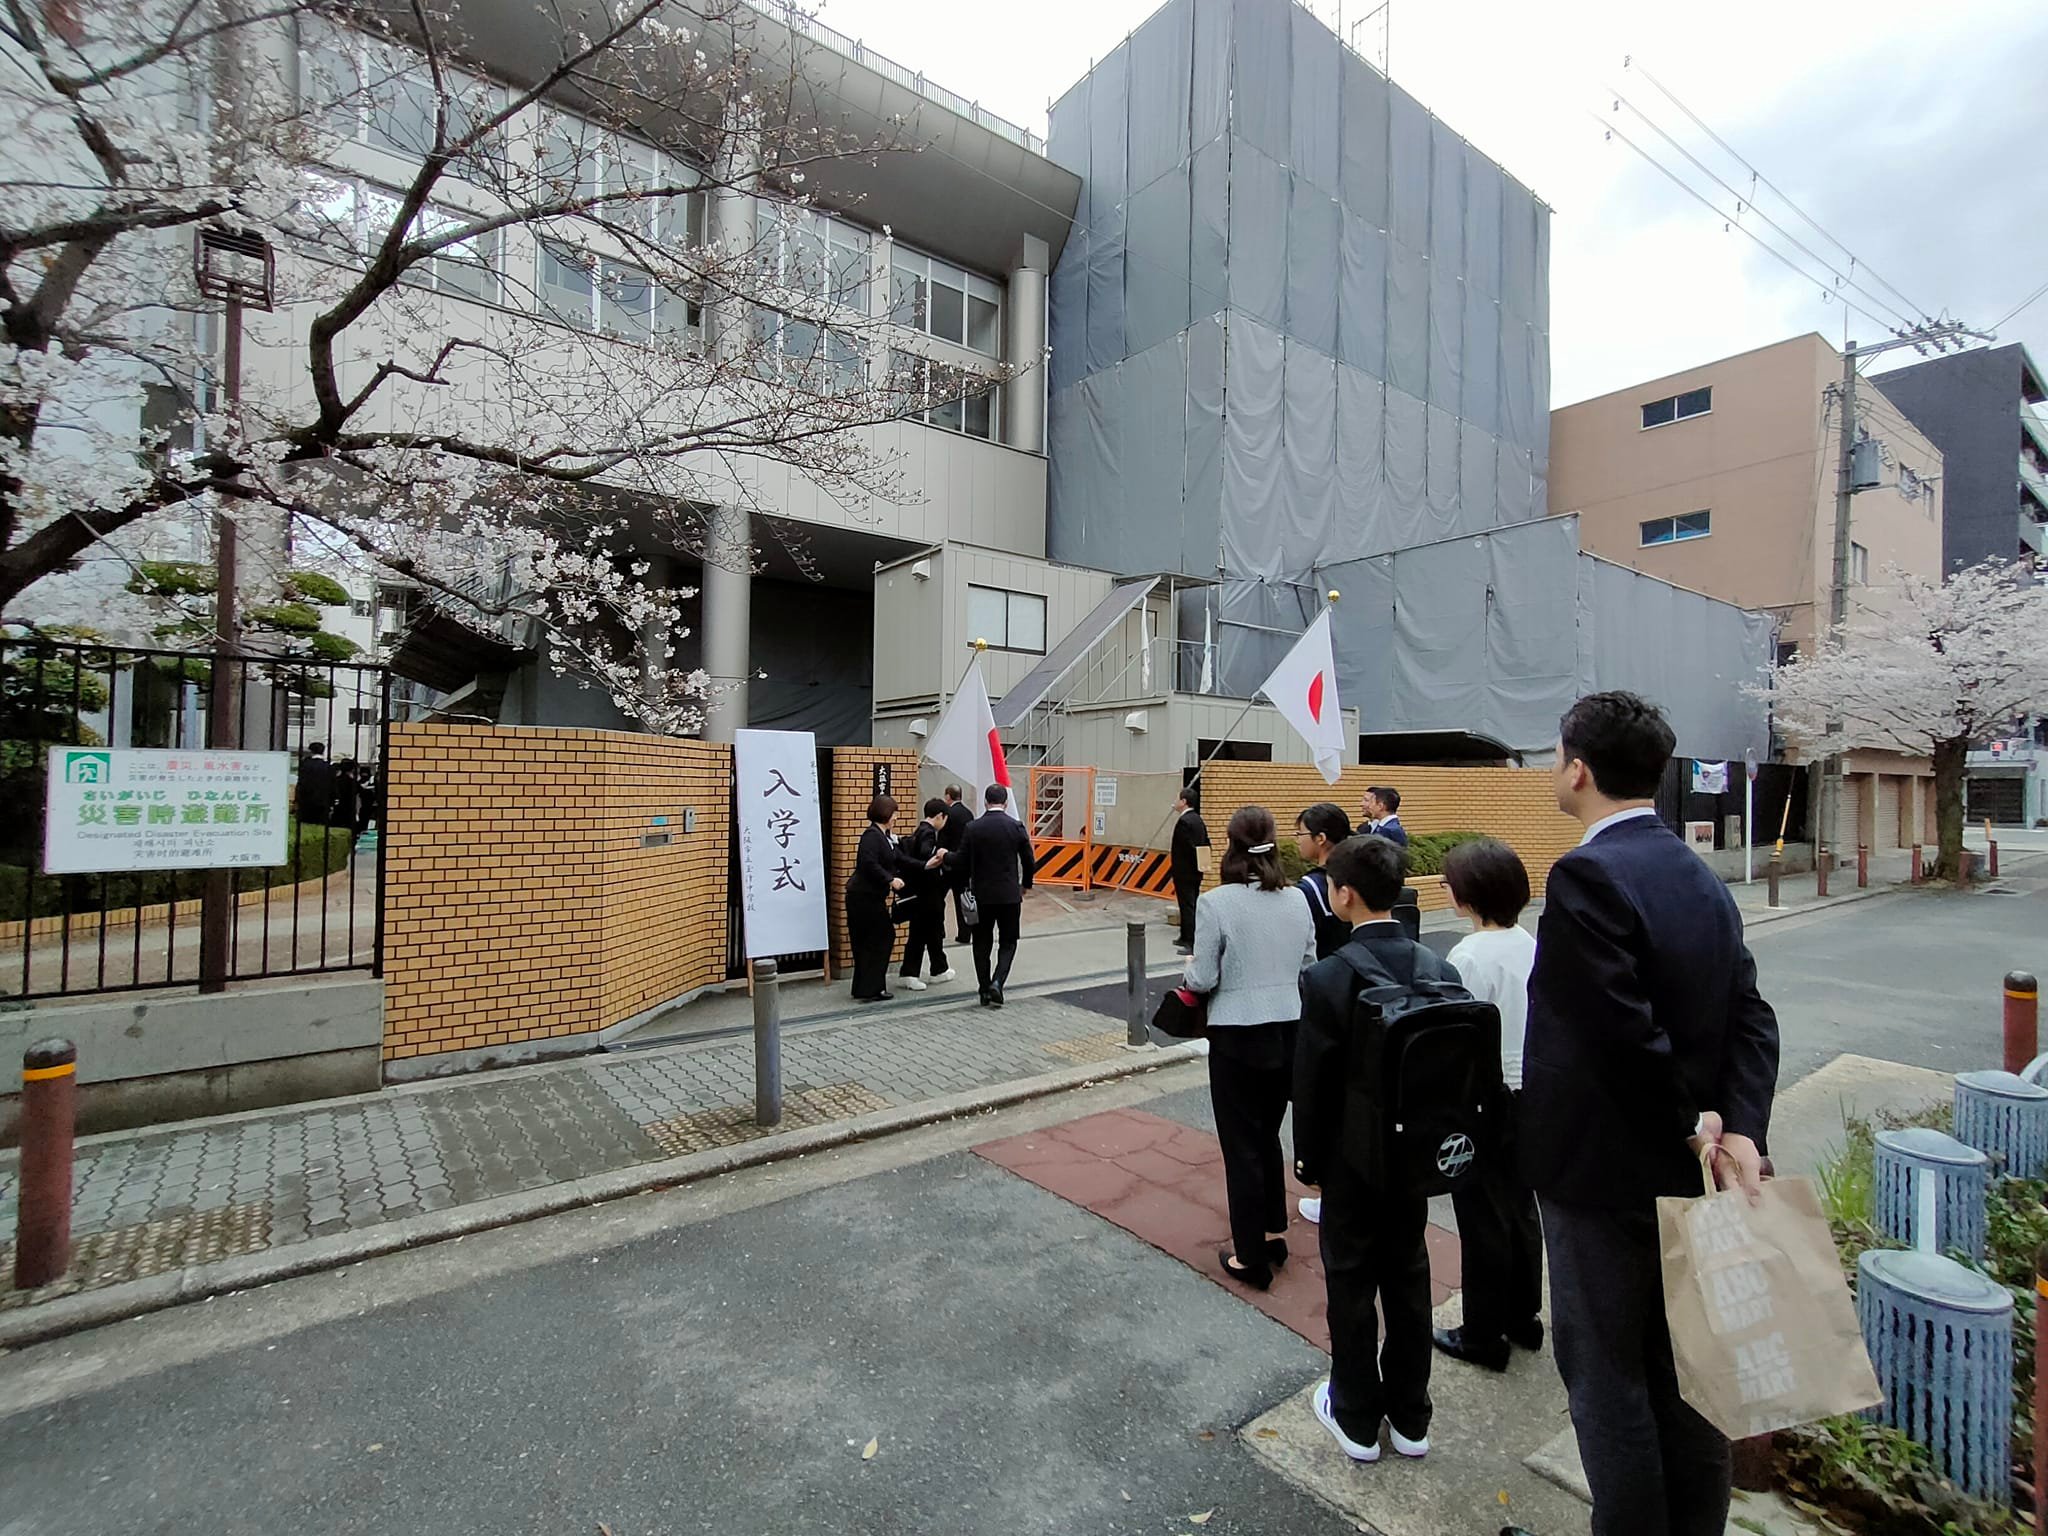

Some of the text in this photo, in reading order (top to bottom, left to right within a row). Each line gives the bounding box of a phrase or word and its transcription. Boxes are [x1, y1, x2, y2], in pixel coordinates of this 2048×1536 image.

[83, 790, 262, 801] さいがいじ ひなんじょ
[76, 803, 271, 826] 災害時避難所
[77, 828, 272, 840] Designated Disaster Evacuation Site
[764, 768, 806, 892] 入学式
[229, 853, 261, 863] 大阪市
[1711, 1263, 1769, 1307] ABC
[1718, 1296, 1775, 1334] MART
[1737, 1366, 1797, 1401] MART
